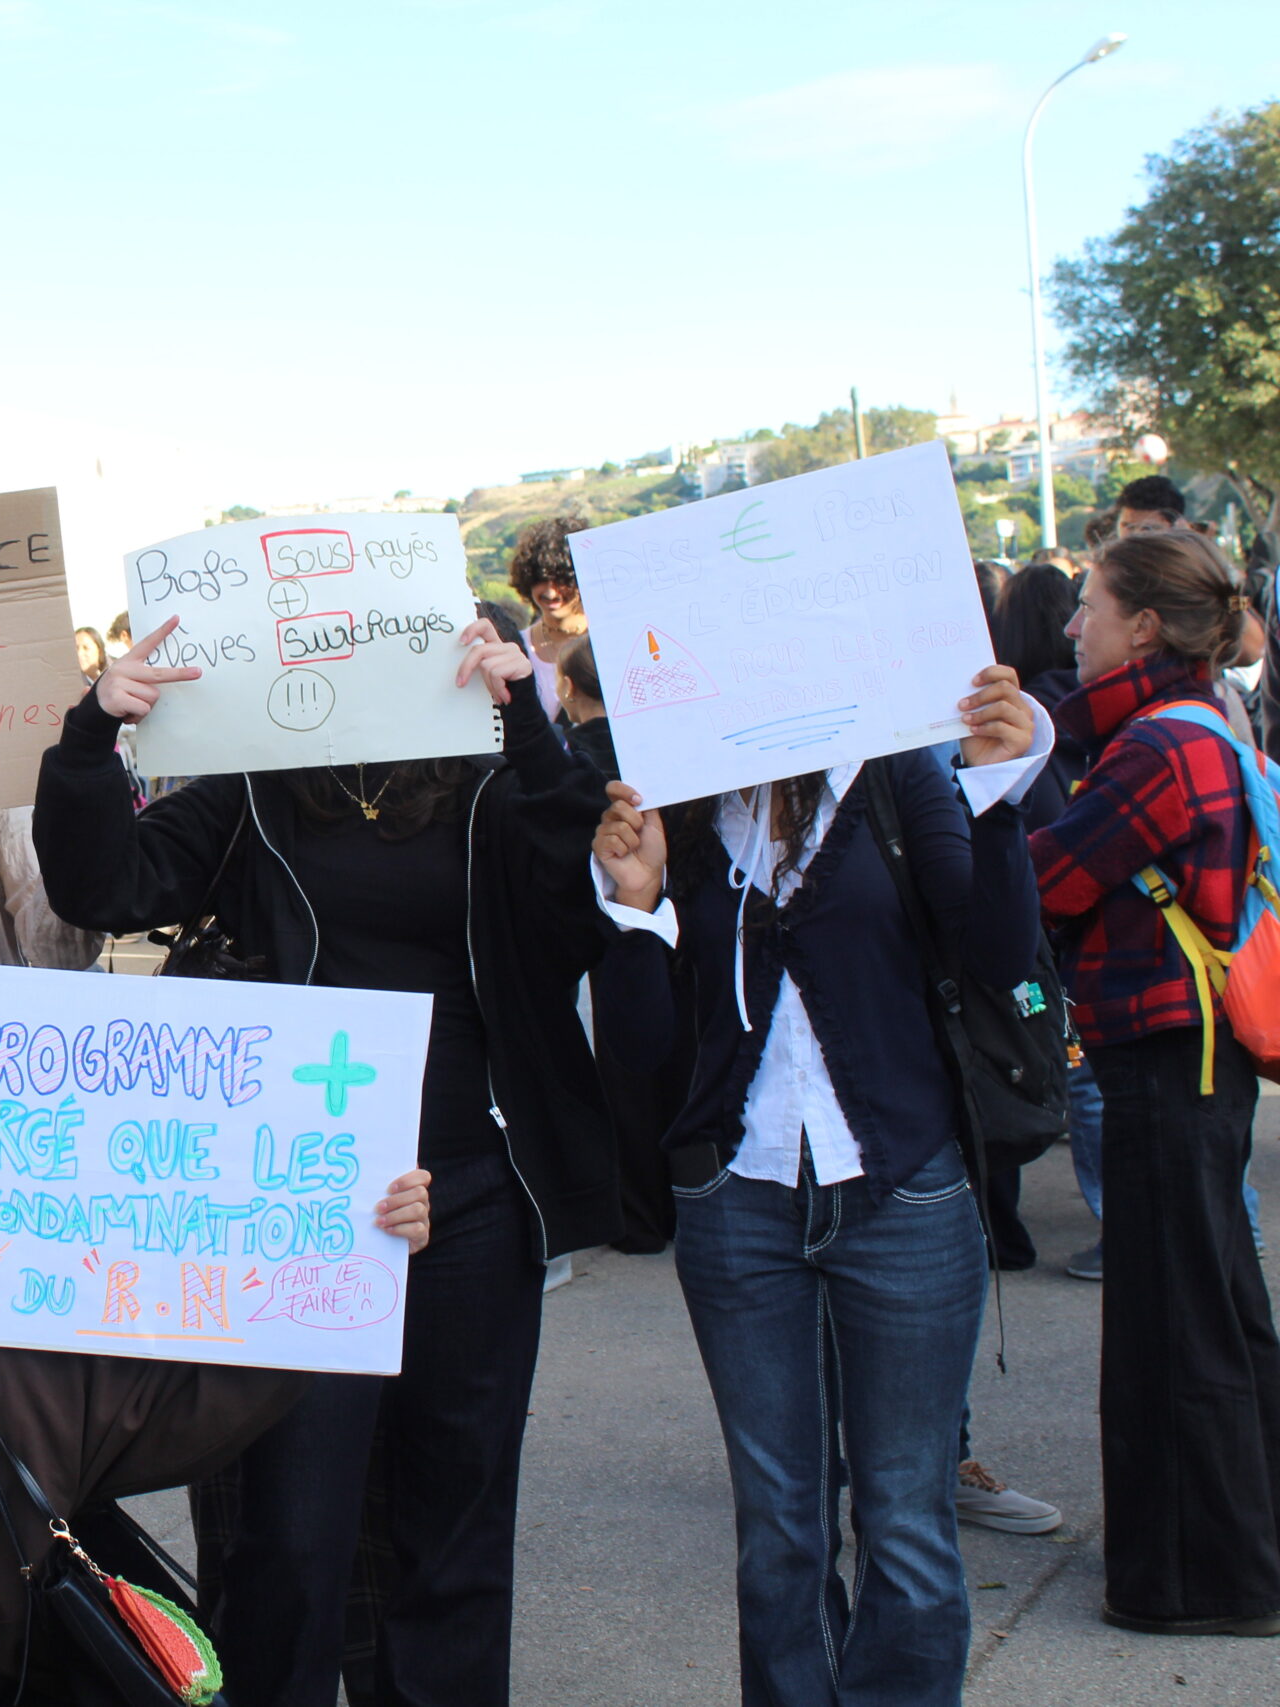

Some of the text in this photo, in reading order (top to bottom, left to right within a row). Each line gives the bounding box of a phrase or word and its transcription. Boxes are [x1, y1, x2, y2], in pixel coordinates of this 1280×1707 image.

[720, 501, 796, 563] €
[813, 489, 914, 542] POUR
[135, 549, 249, 606] Profs
[730, 636, 808, 683] POUR
[832, 628, 893, 663] LES
[908, 620, 977, 654] GROS
[706, 678, 844, 733] PATRONS
[108, 1118, 220, 1184] QUE
[254, 1123, 360, 1195] LES
[11, 1266, 77, 1317] DU
[280, 1262, 362, 1290] FAUT LE
